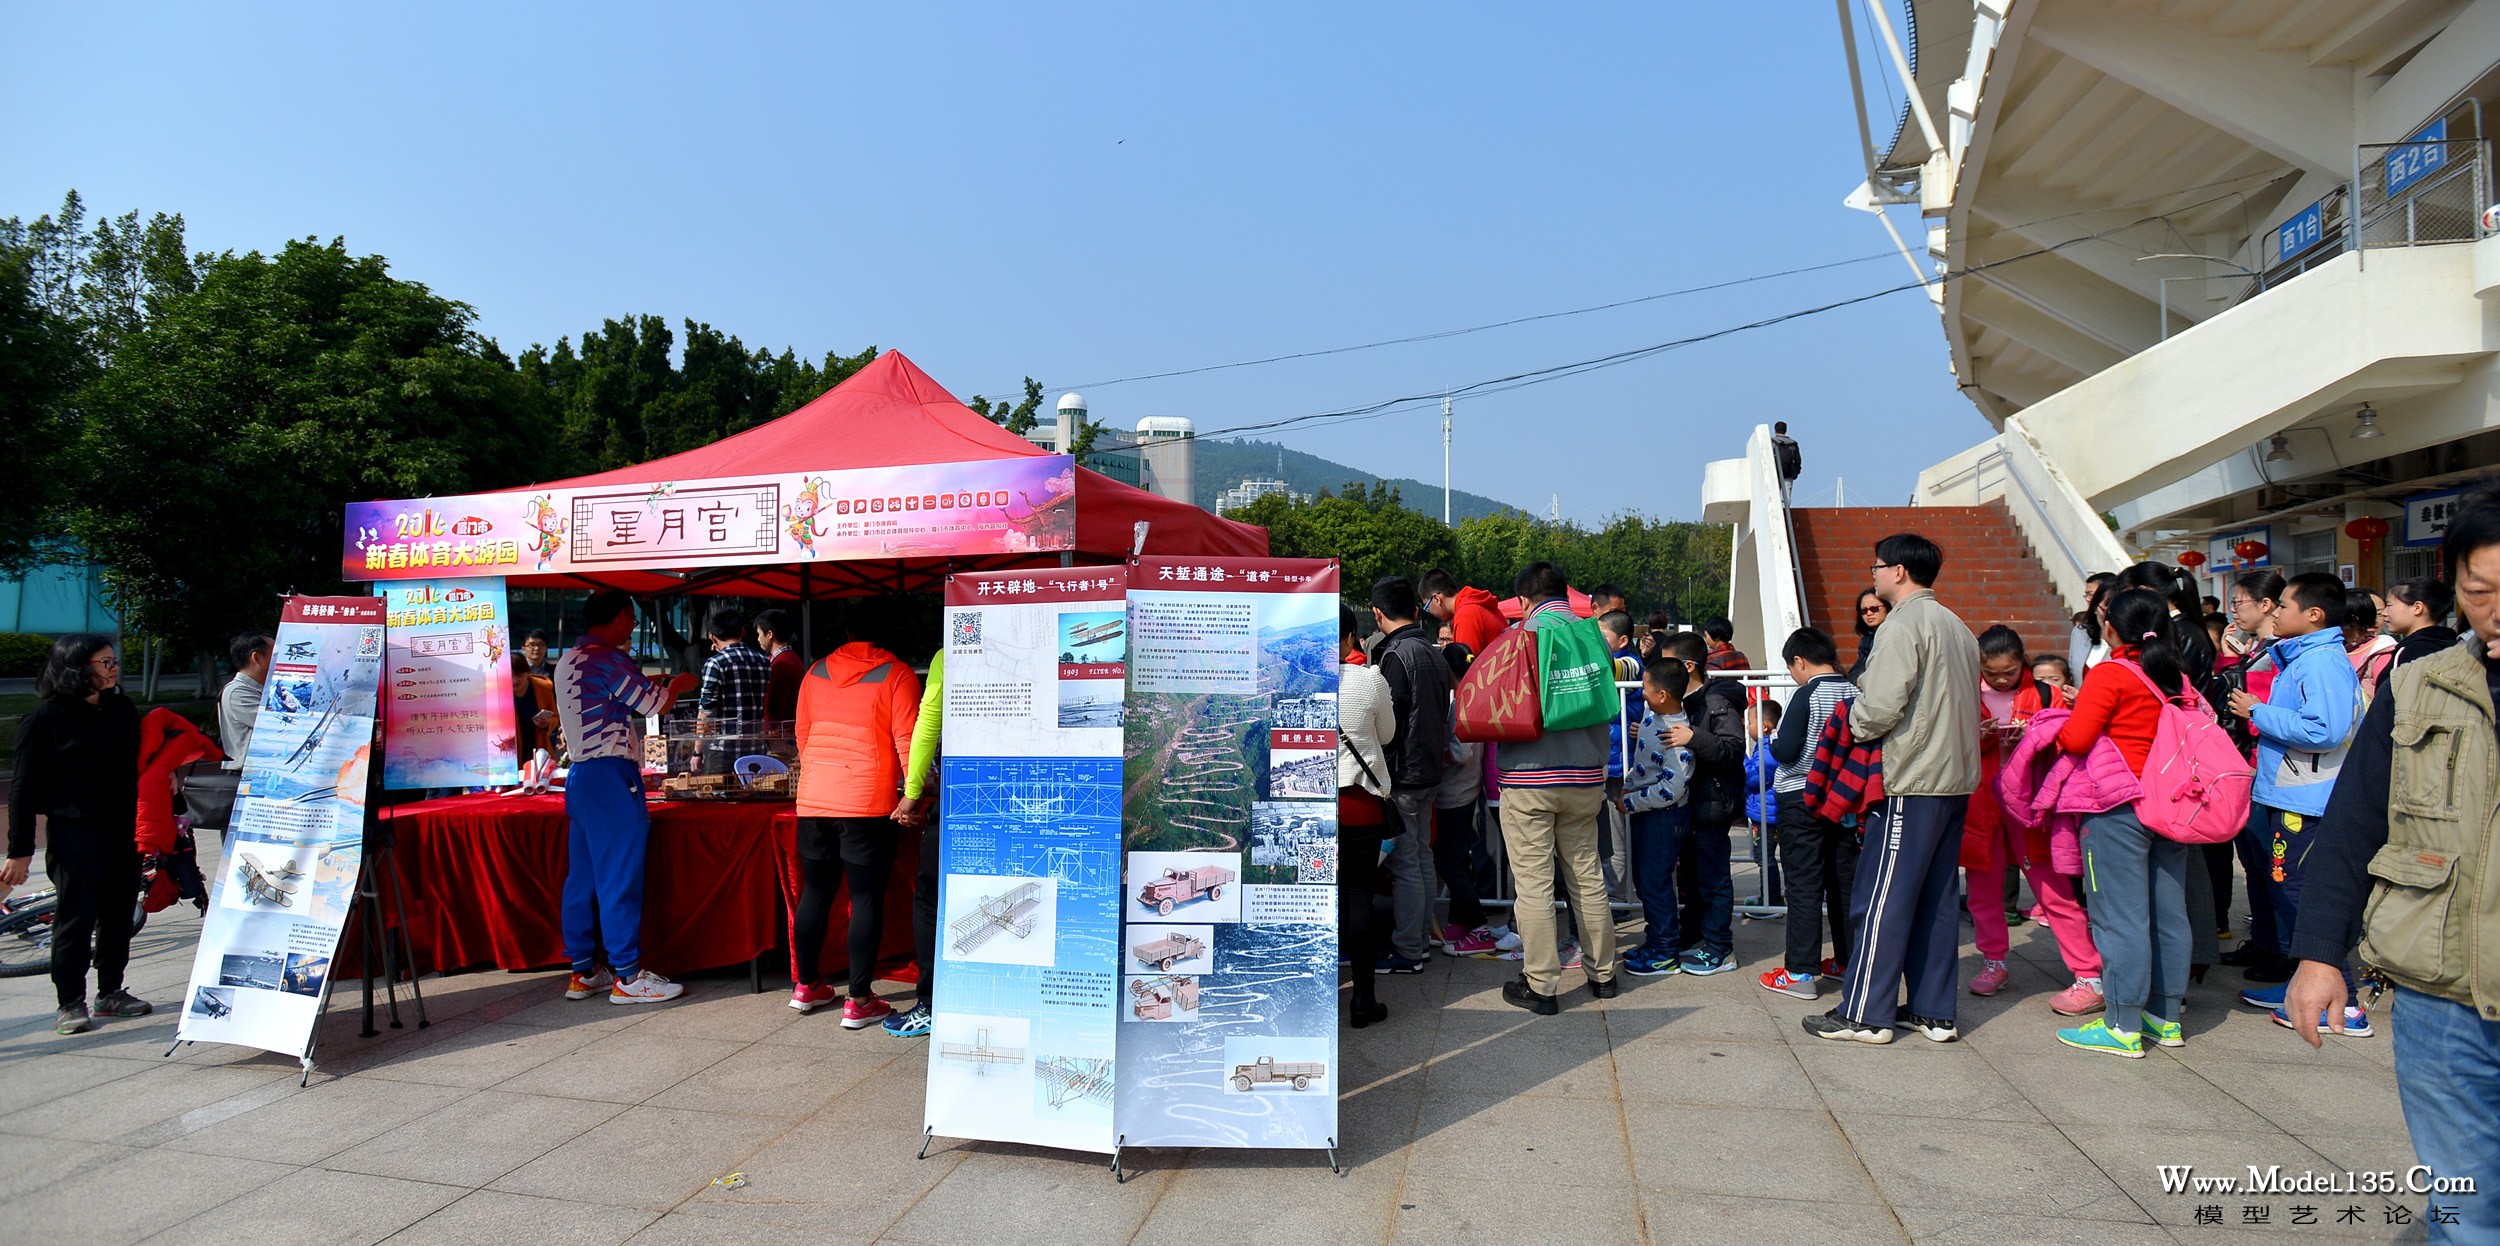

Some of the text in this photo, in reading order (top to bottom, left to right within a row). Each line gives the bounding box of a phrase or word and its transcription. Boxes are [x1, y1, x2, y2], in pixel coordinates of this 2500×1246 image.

[2389, 135, 2439, 187] 西2台
[2282, 213, 2318, 254] 西1台
[607, 501, 739, 547] 星月宫
[365, 537, 520, 570] 新春体育大游园
[386, 602, 496, 628] 新春体育大游园
[421, 639, 462, 653] 星月宫
[1063, 668, 1079, 677] 1903
[1281, 733, 1326, 743] 南侨机工
[1889, 813, 1904, 850] ENERGY
